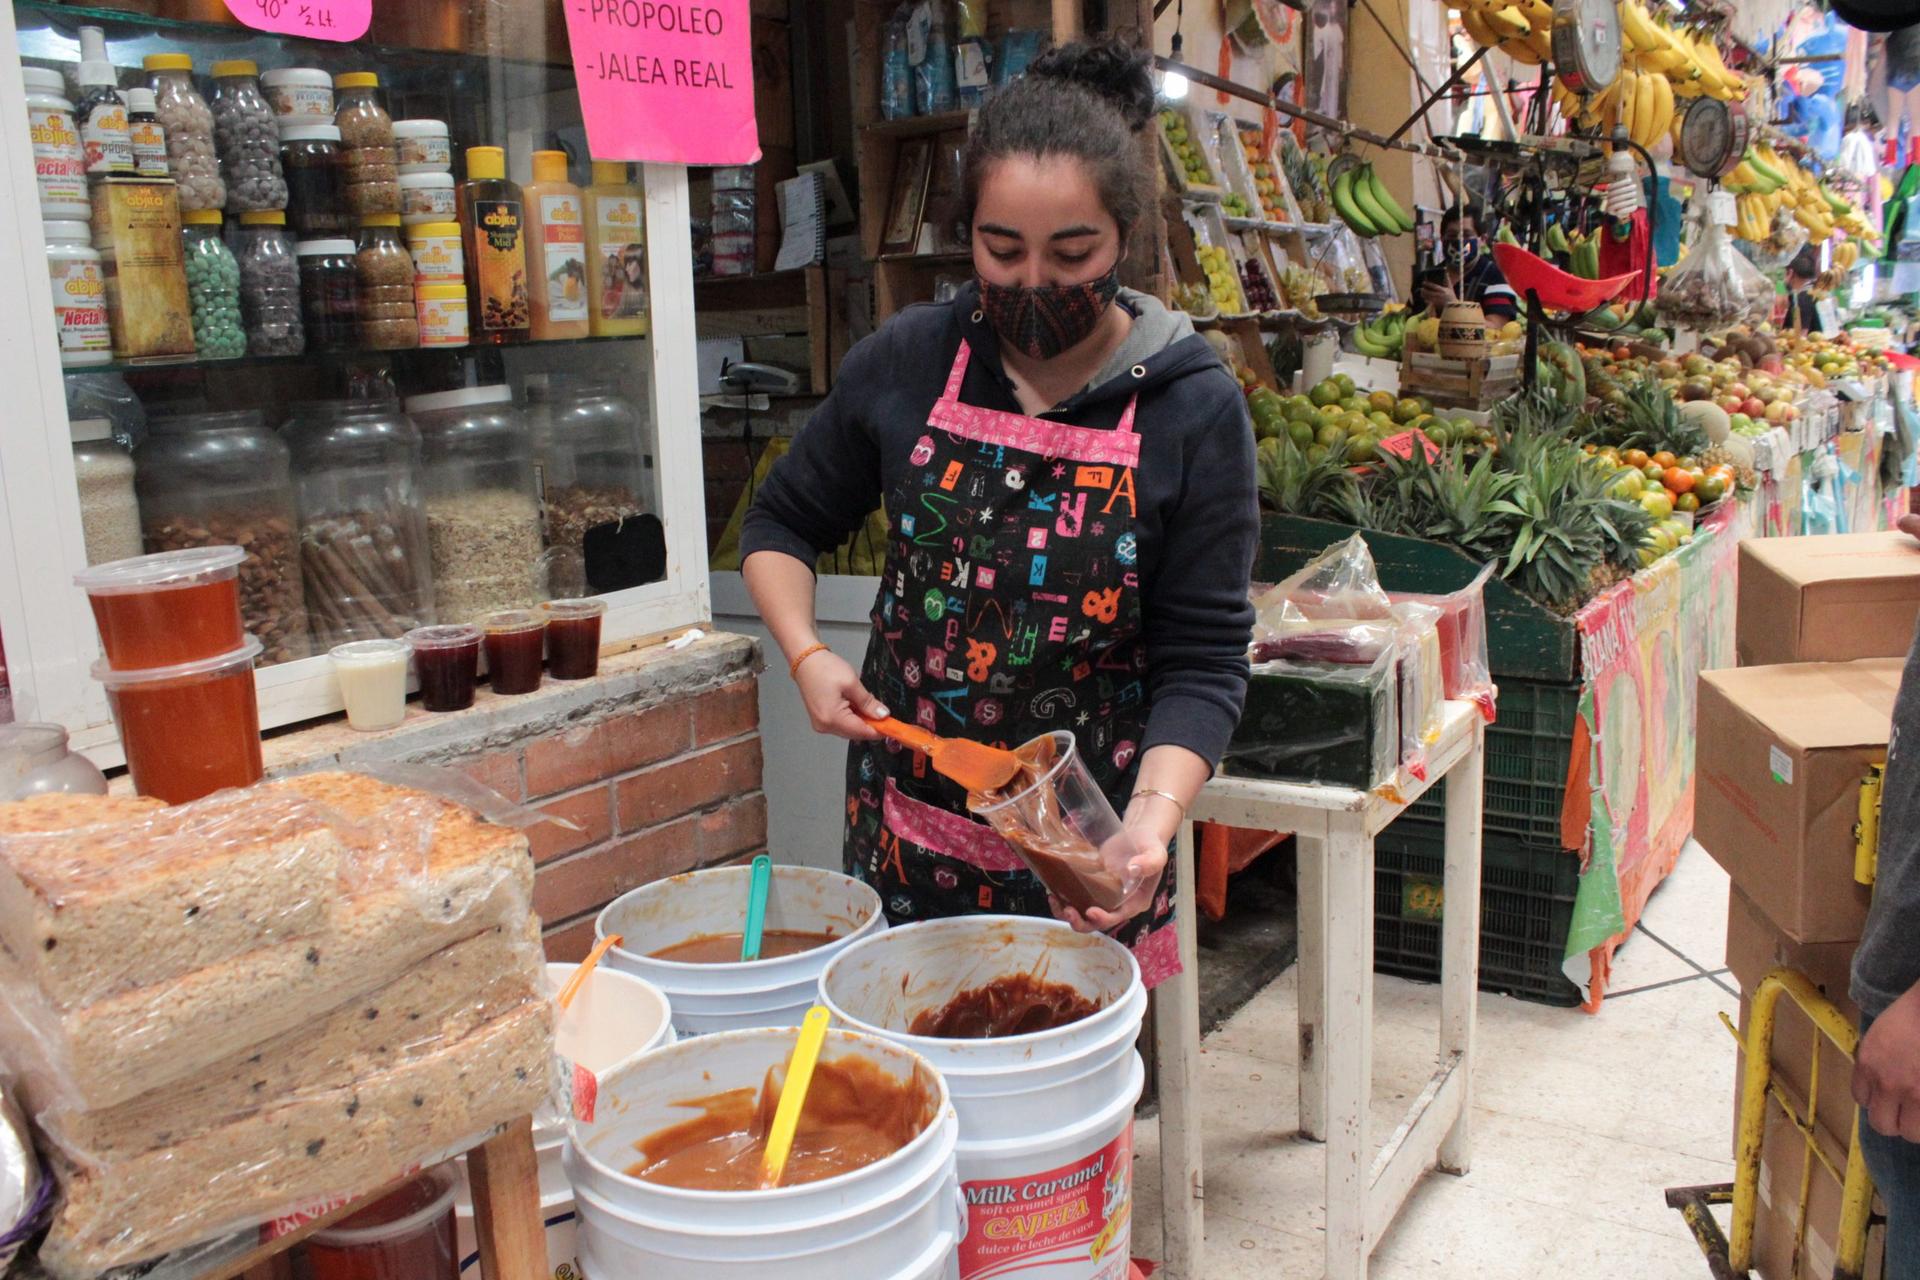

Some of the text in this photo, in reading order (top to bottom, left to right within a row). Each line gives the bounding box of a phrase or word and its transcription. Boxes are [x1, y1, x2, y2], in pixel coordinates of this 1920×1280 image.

[674, 59, 734, 89] REAL
[967, 1154, 1104, 1205] Milk Caramel
[981, 1182, 1090, 1217] soft caramel spread
[983, 1196, 1090, 1241] CAJETA
[977, 1243, 1009, 1255] dulce
[1012, 1241, 1025, 1252] de
[1028, 1234, 1055, 1249] leche
[1058, 1229, 1071, 1241] de
